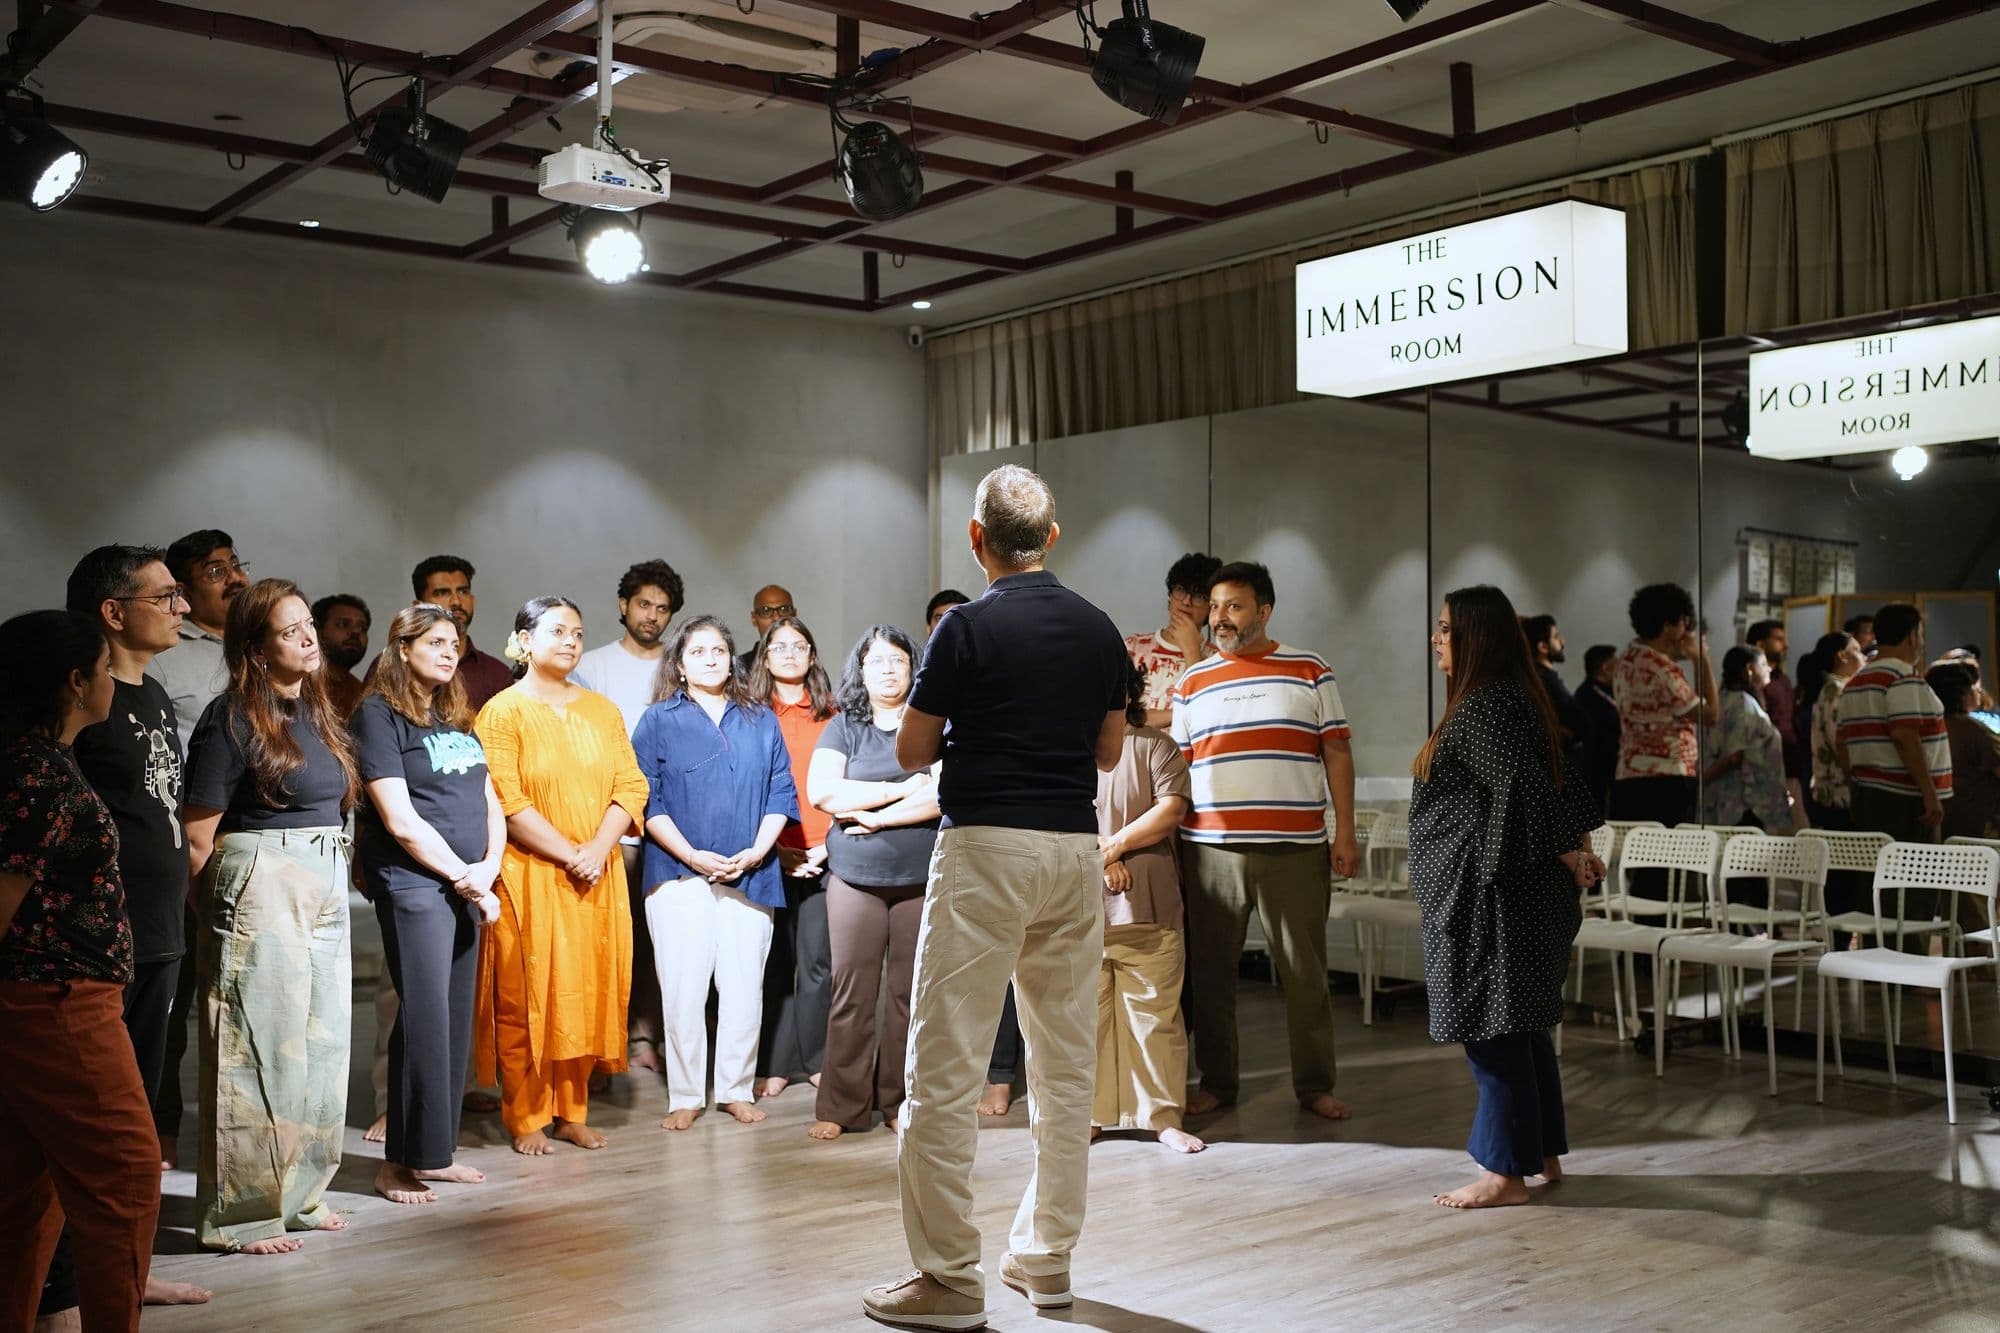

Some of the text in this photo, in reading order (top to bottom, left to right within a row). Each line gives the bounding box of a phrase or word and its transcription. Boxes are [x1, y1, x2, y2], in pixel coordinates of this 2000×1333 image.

[1402, 236, 1448, 265] THE
[1307, 256, 1559, 338] IMMERSION
[1391, 333, 1461, 363] ROOM
